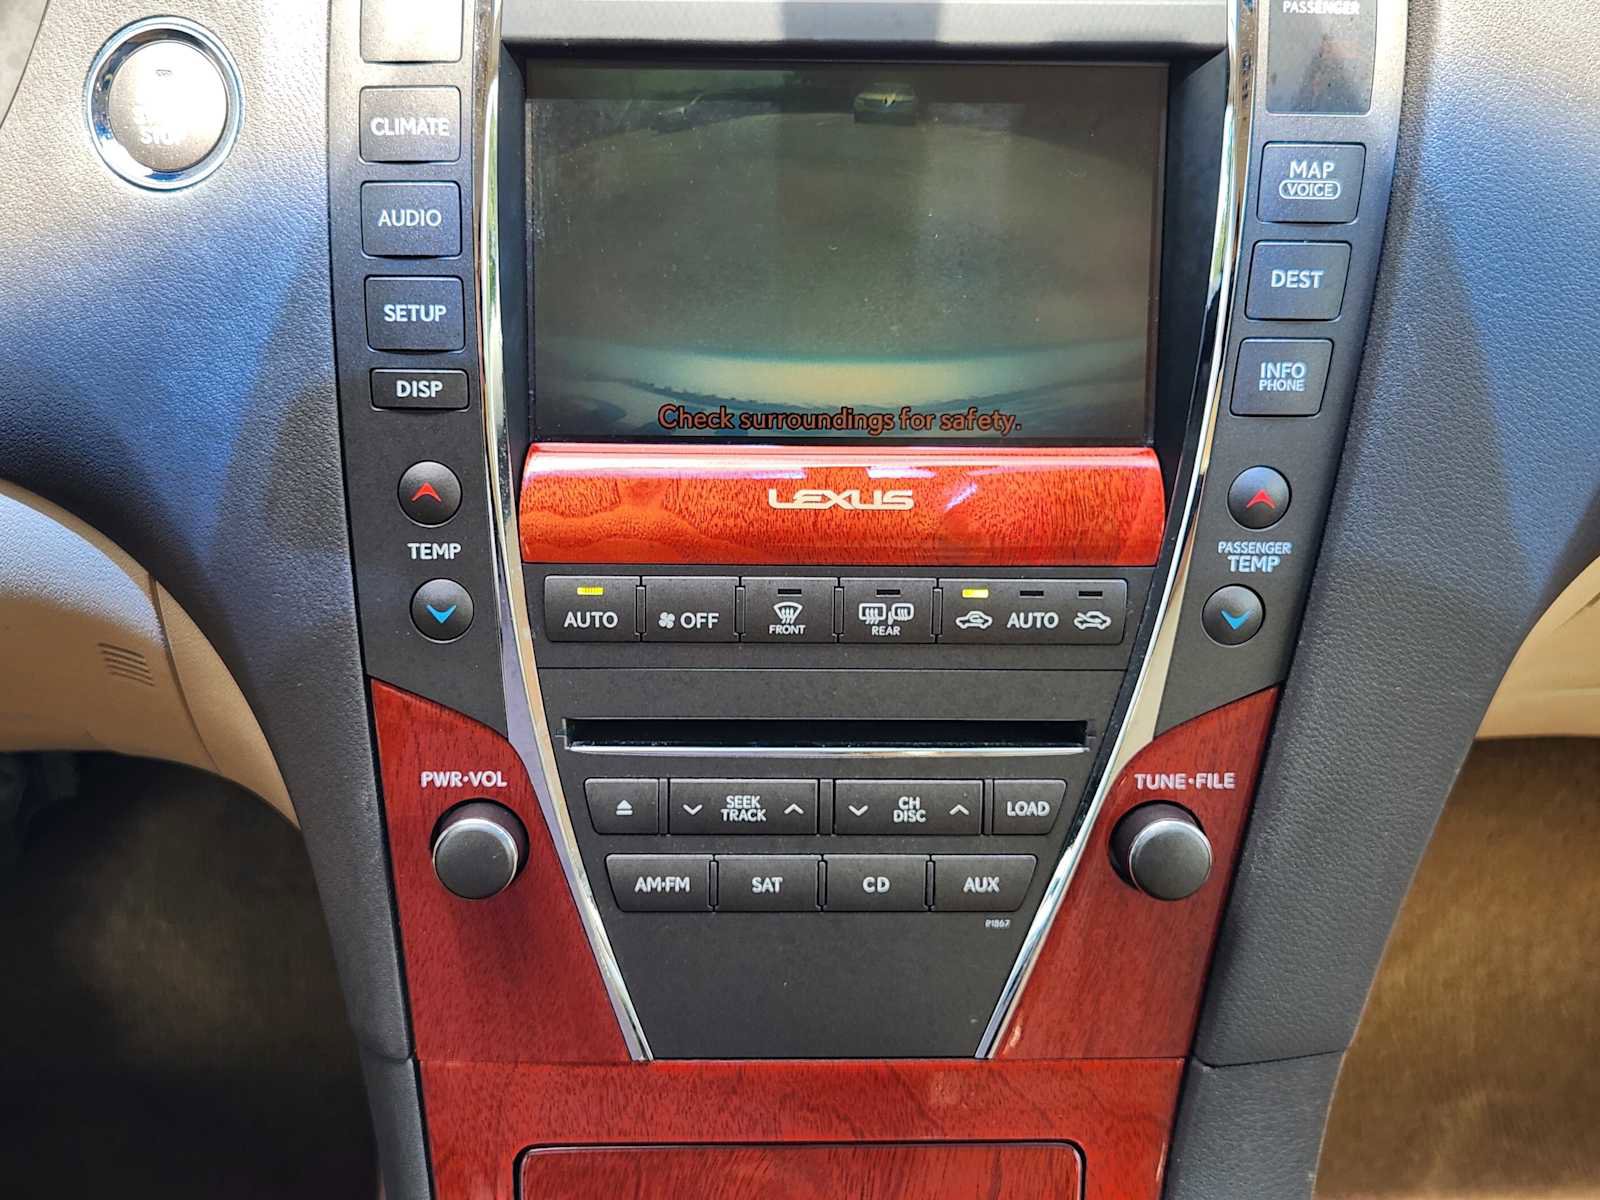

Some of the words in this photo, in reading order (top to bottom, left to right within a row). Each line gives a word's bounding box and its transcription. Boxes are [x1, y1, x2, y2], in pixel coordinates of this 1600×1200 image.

[1282, 0, 1360, 15] PASSENGER
[370, 116, 450, 136] CLIMATE
[1289, 160, 1335, 179] MAP
[1286, 182, 1334, 197] VOICE
[378, 208, 442, 227] AUDIO
[1270, 269, 1324, 289] DEST
[383, 304, 447, 323] SETUP
[1260, 361, 1306, 379] INFO
[396, 379, 443, 398] DISP
[1258, 379, 1305, 391] PHONE
[658, 403, 737, 430] Check
[739, 406, 894, 435] surroundings
[899, 407, 936, 431] for
[939, 407, 1023, 434] safety.
[767, 487, 915, 511] LEXUS
[406, 542, 462, 560] TEMP
[1217, 540, 1293, 555] PASSENGER
[1227, 554, 1281, 573] TEMP
[563, 611, 619, 629] AUTO
[680, 612, 720, 630] OFF
[1006, 612, 1060, 629] AUTO
[768, 624, 806, 635] FRONT
[871, 626, 901, 636] REAR
[726, 795, 761, 809] SEEK
[899, 796, 921, 810] CH
[1006, 800, 1051, 817] LOAD
[720, 808, 767, 822] TRACK
[893, 810, 927, 823] DISC
[751, 876, 784, 894] SAT
[862, 876, 891, 893] CD
[962, 876, 1000, 893] AUX
